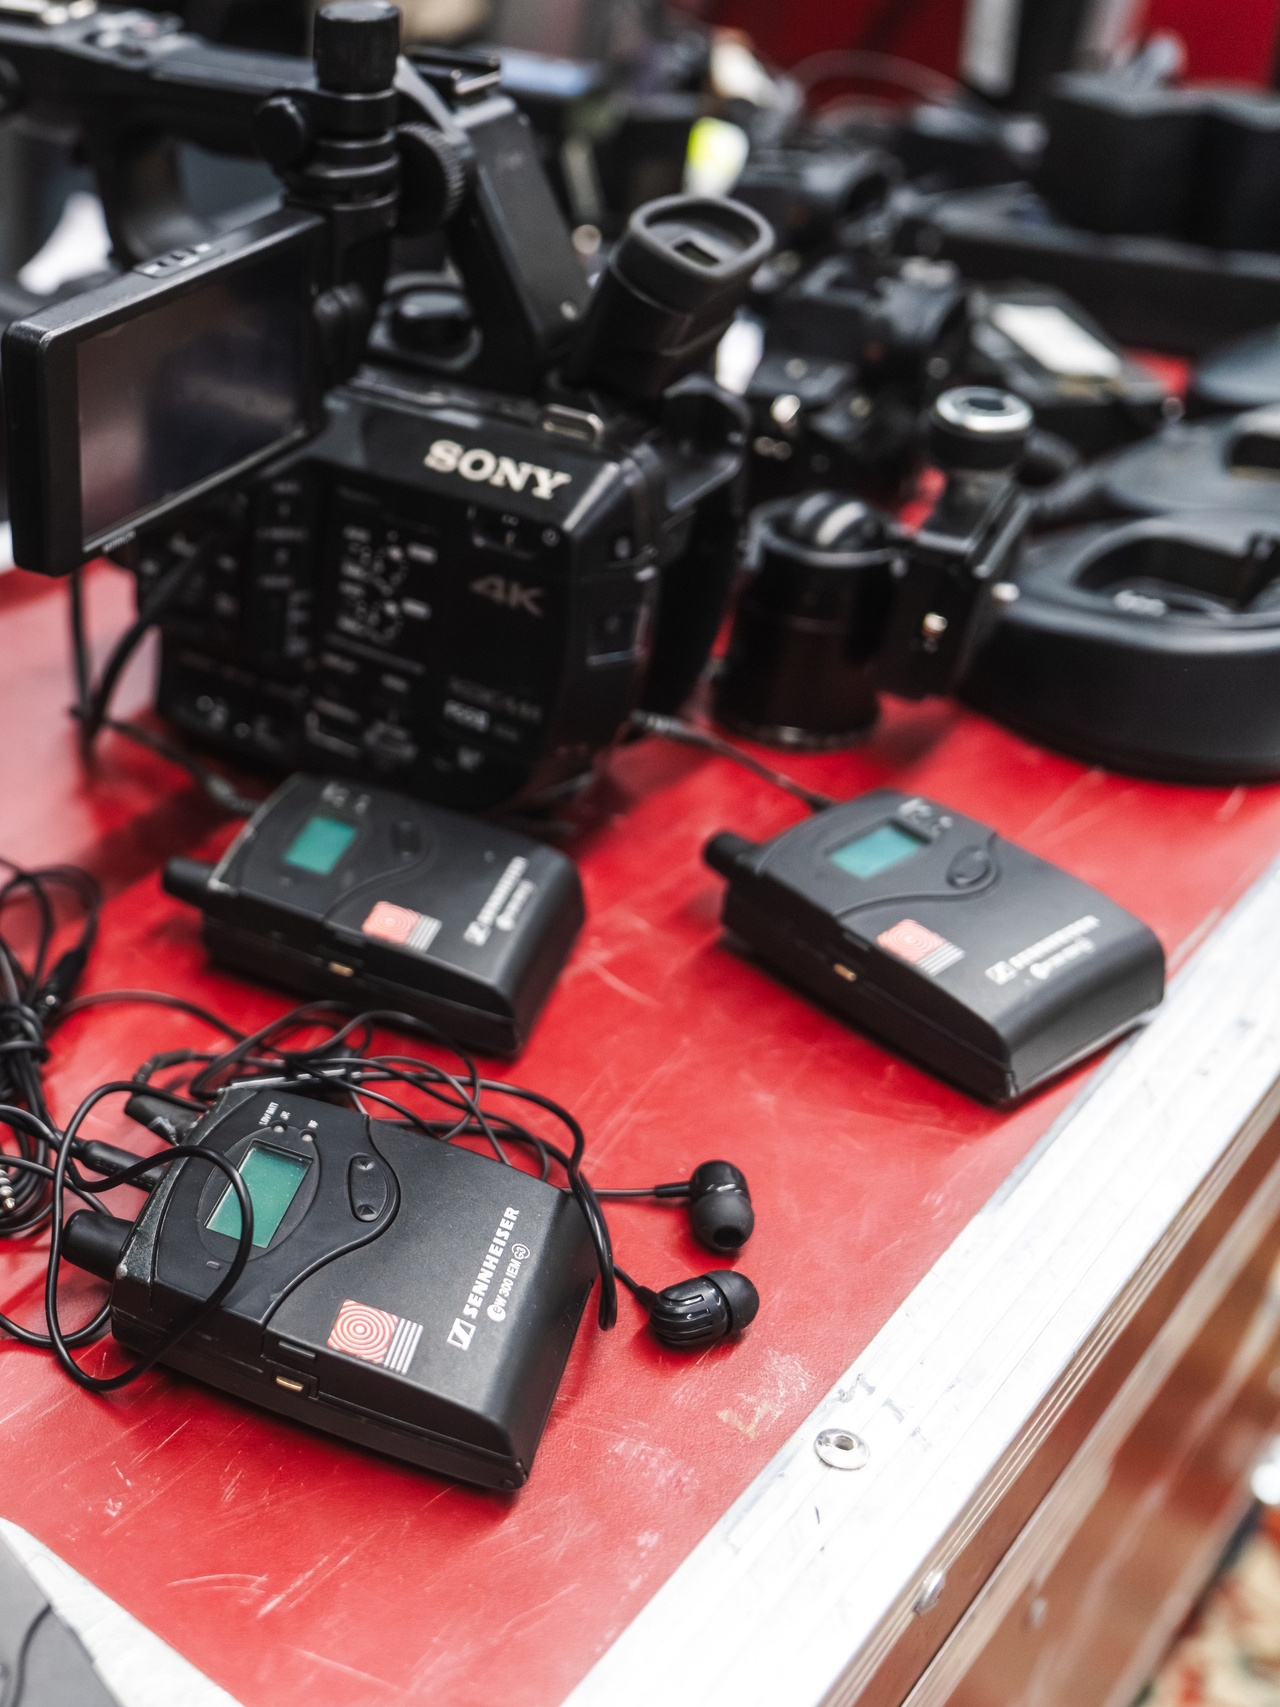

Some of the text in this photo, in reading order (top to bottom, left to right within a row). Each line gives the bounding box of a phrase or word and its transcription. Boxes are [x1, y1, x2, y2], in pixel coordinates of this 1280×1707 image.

[423, 439, 572, 500] SONY
[469, 576, 543, 617] 4K
[462, 1206, 520, 1319] SENNHEISER
[505, 1258, 522, 1279] IEM
[498, 1277, 514, 1298] 300
